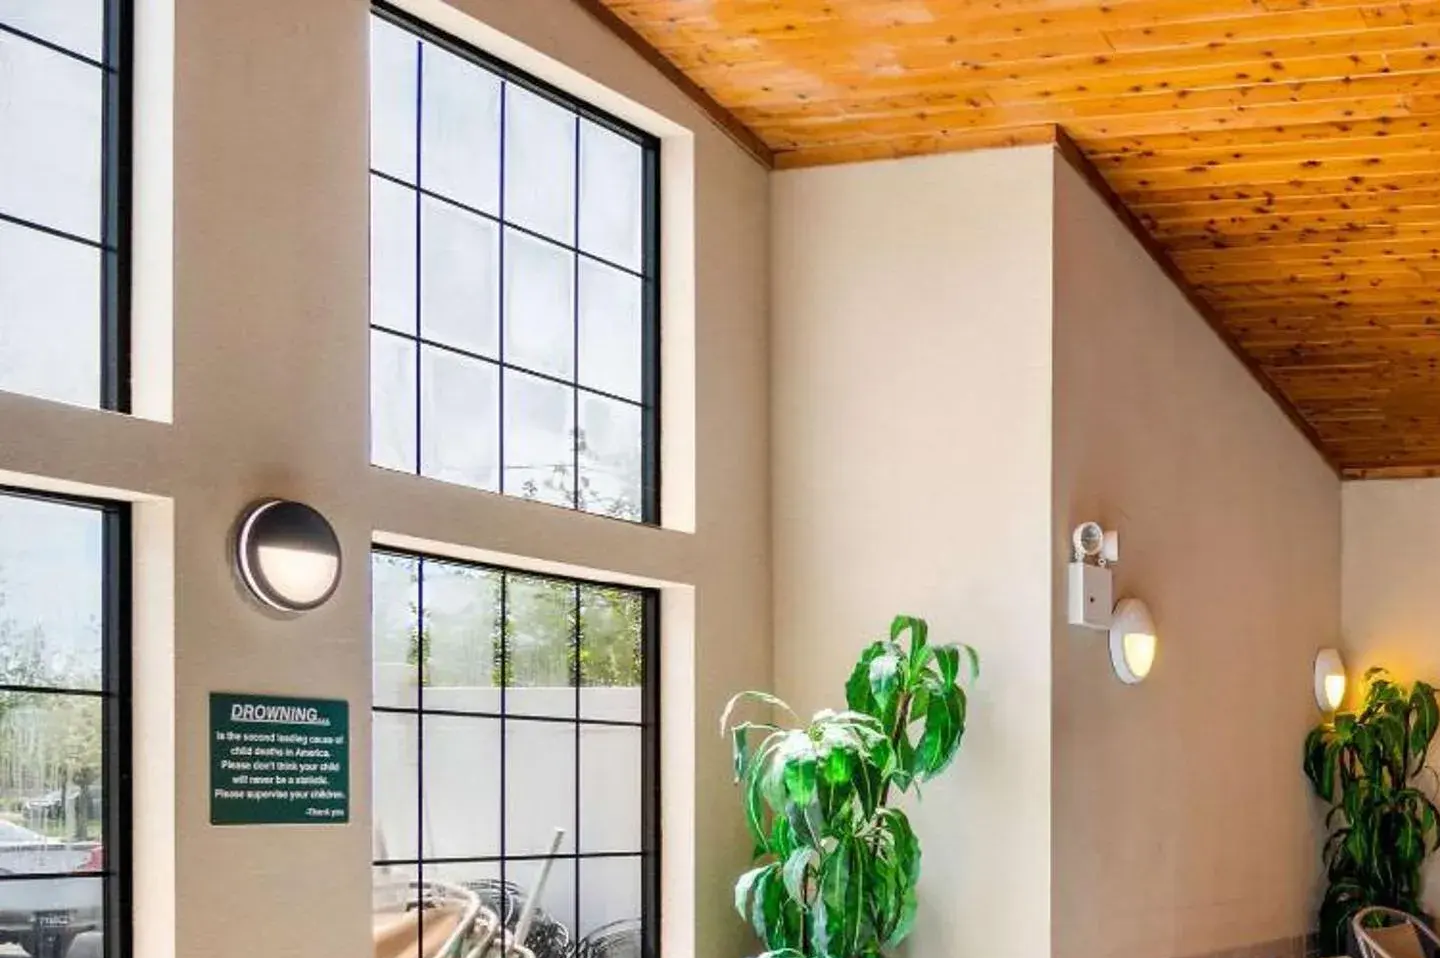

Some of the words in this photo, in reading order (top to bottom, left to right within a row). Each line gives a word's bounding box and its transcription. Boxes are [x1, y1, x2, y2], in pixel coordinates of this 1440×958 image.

[226, 731, 241, 740] the
[243, 733, 275, 742] second
[276, 733, 308, 746] leading
[309, 736, 333, 744] cause
[230, 746, 252, 756] child
[254, 747, 283, 757] deaths
[285, 748, 294, 757] in
[221, 760, 252, 770] Please
[253, 761, 275, 770] don't
[276, 761, 298, 771] think
[299, 763, 318, 773] your
[320, 761, 340, 771] child
[232, 775, 248, 784] will
[249, 776, 273, 784] never
[275, 775, 287, 784] be
[214, 789, 244, 799] Please
[247, 790, 288, 803] supervise
[289, 791, 308, 802] your
